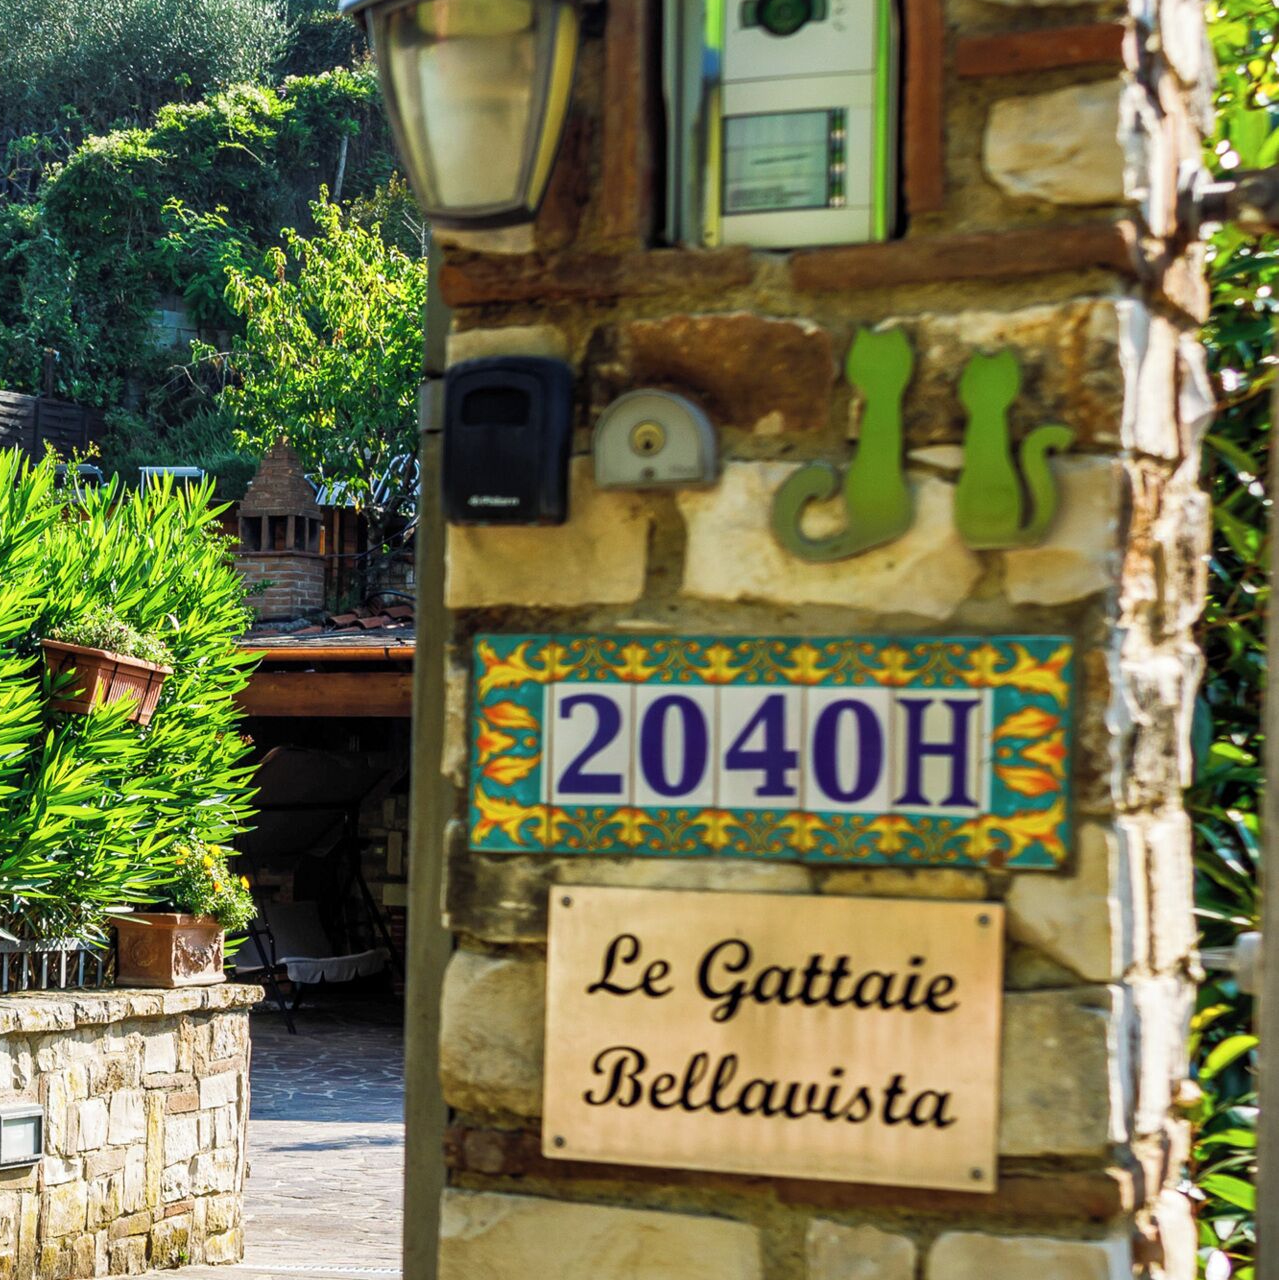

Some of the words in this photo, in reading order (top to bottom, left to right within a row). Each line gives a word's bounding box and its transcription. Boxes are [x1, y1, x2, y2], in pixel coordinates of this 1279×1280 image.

[556, 693, 982, 807] 2040H
[586, 934, 674, 998] Le
[697, 938, 960, 1023] Gattaie
[582, 1046, 958, 1129] Bellavista
